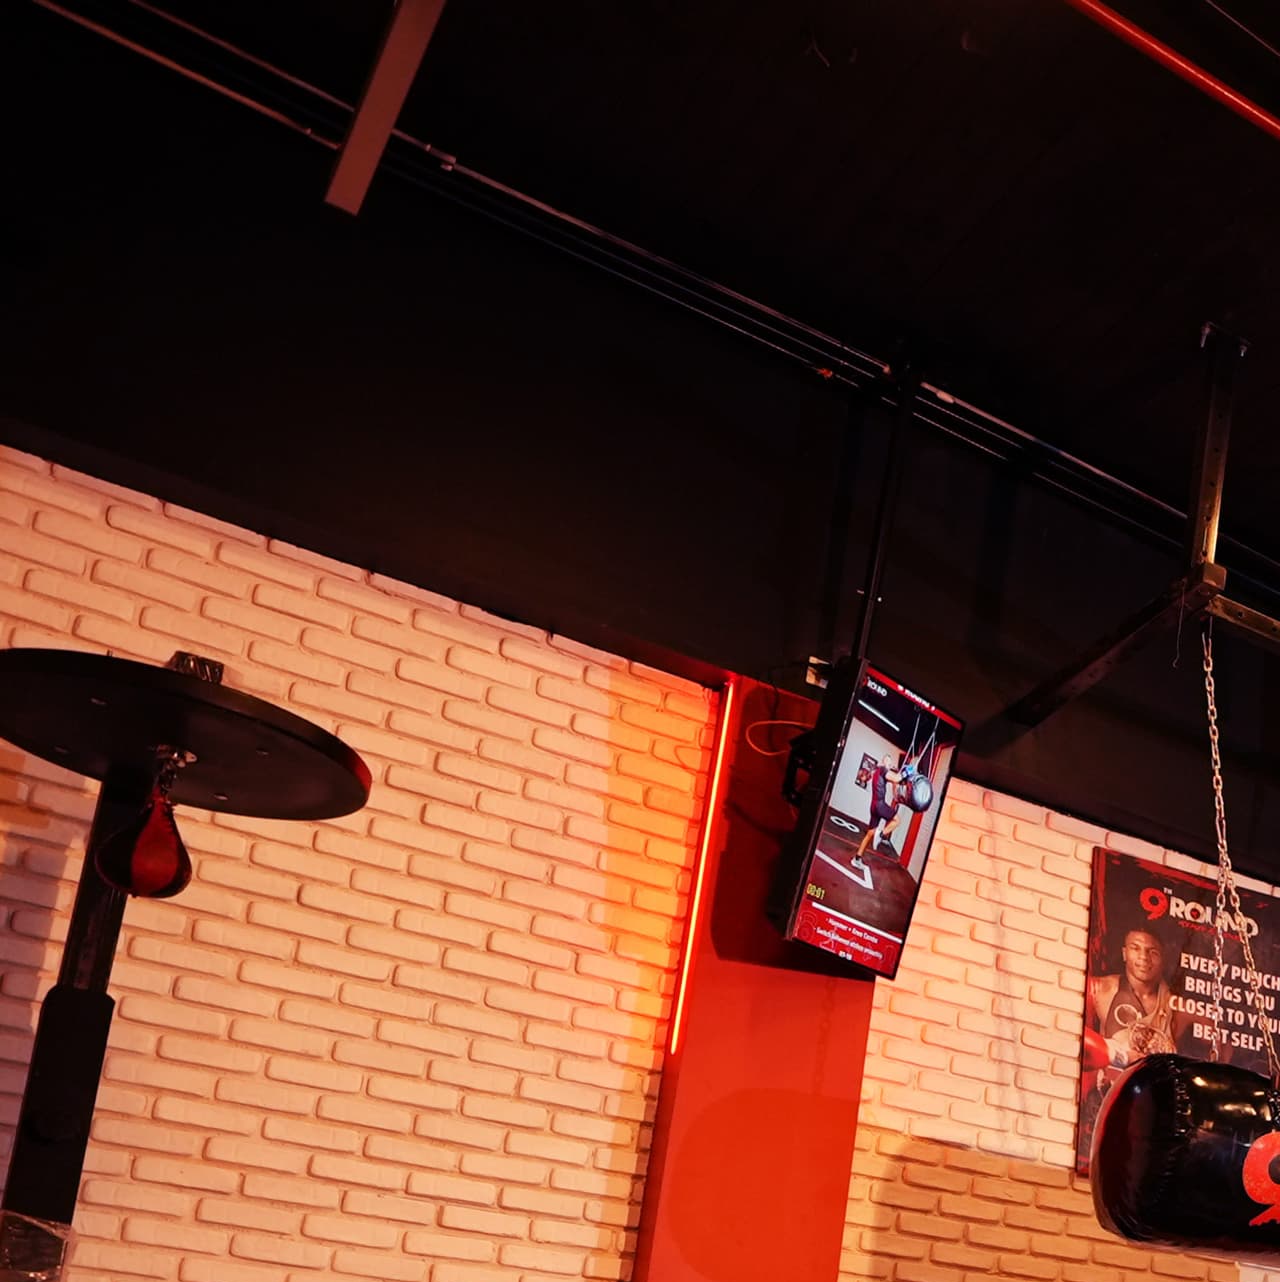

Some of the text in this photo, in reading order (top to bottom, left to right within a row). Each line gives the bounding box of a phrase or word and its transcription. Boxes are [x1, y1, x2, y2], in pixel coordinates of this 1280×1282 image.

[1169, 896, 1259, 938] ROUND
[1180, 952, 1280, 992] EVERY PUNCH
[1169, 995, 1224, 1022] CLOSER
[1226, 1008, 1245, 1026] TO
[1244, 990, 1275, 1012] YOU
[1231, 1032, 1264, 1051] SELF
